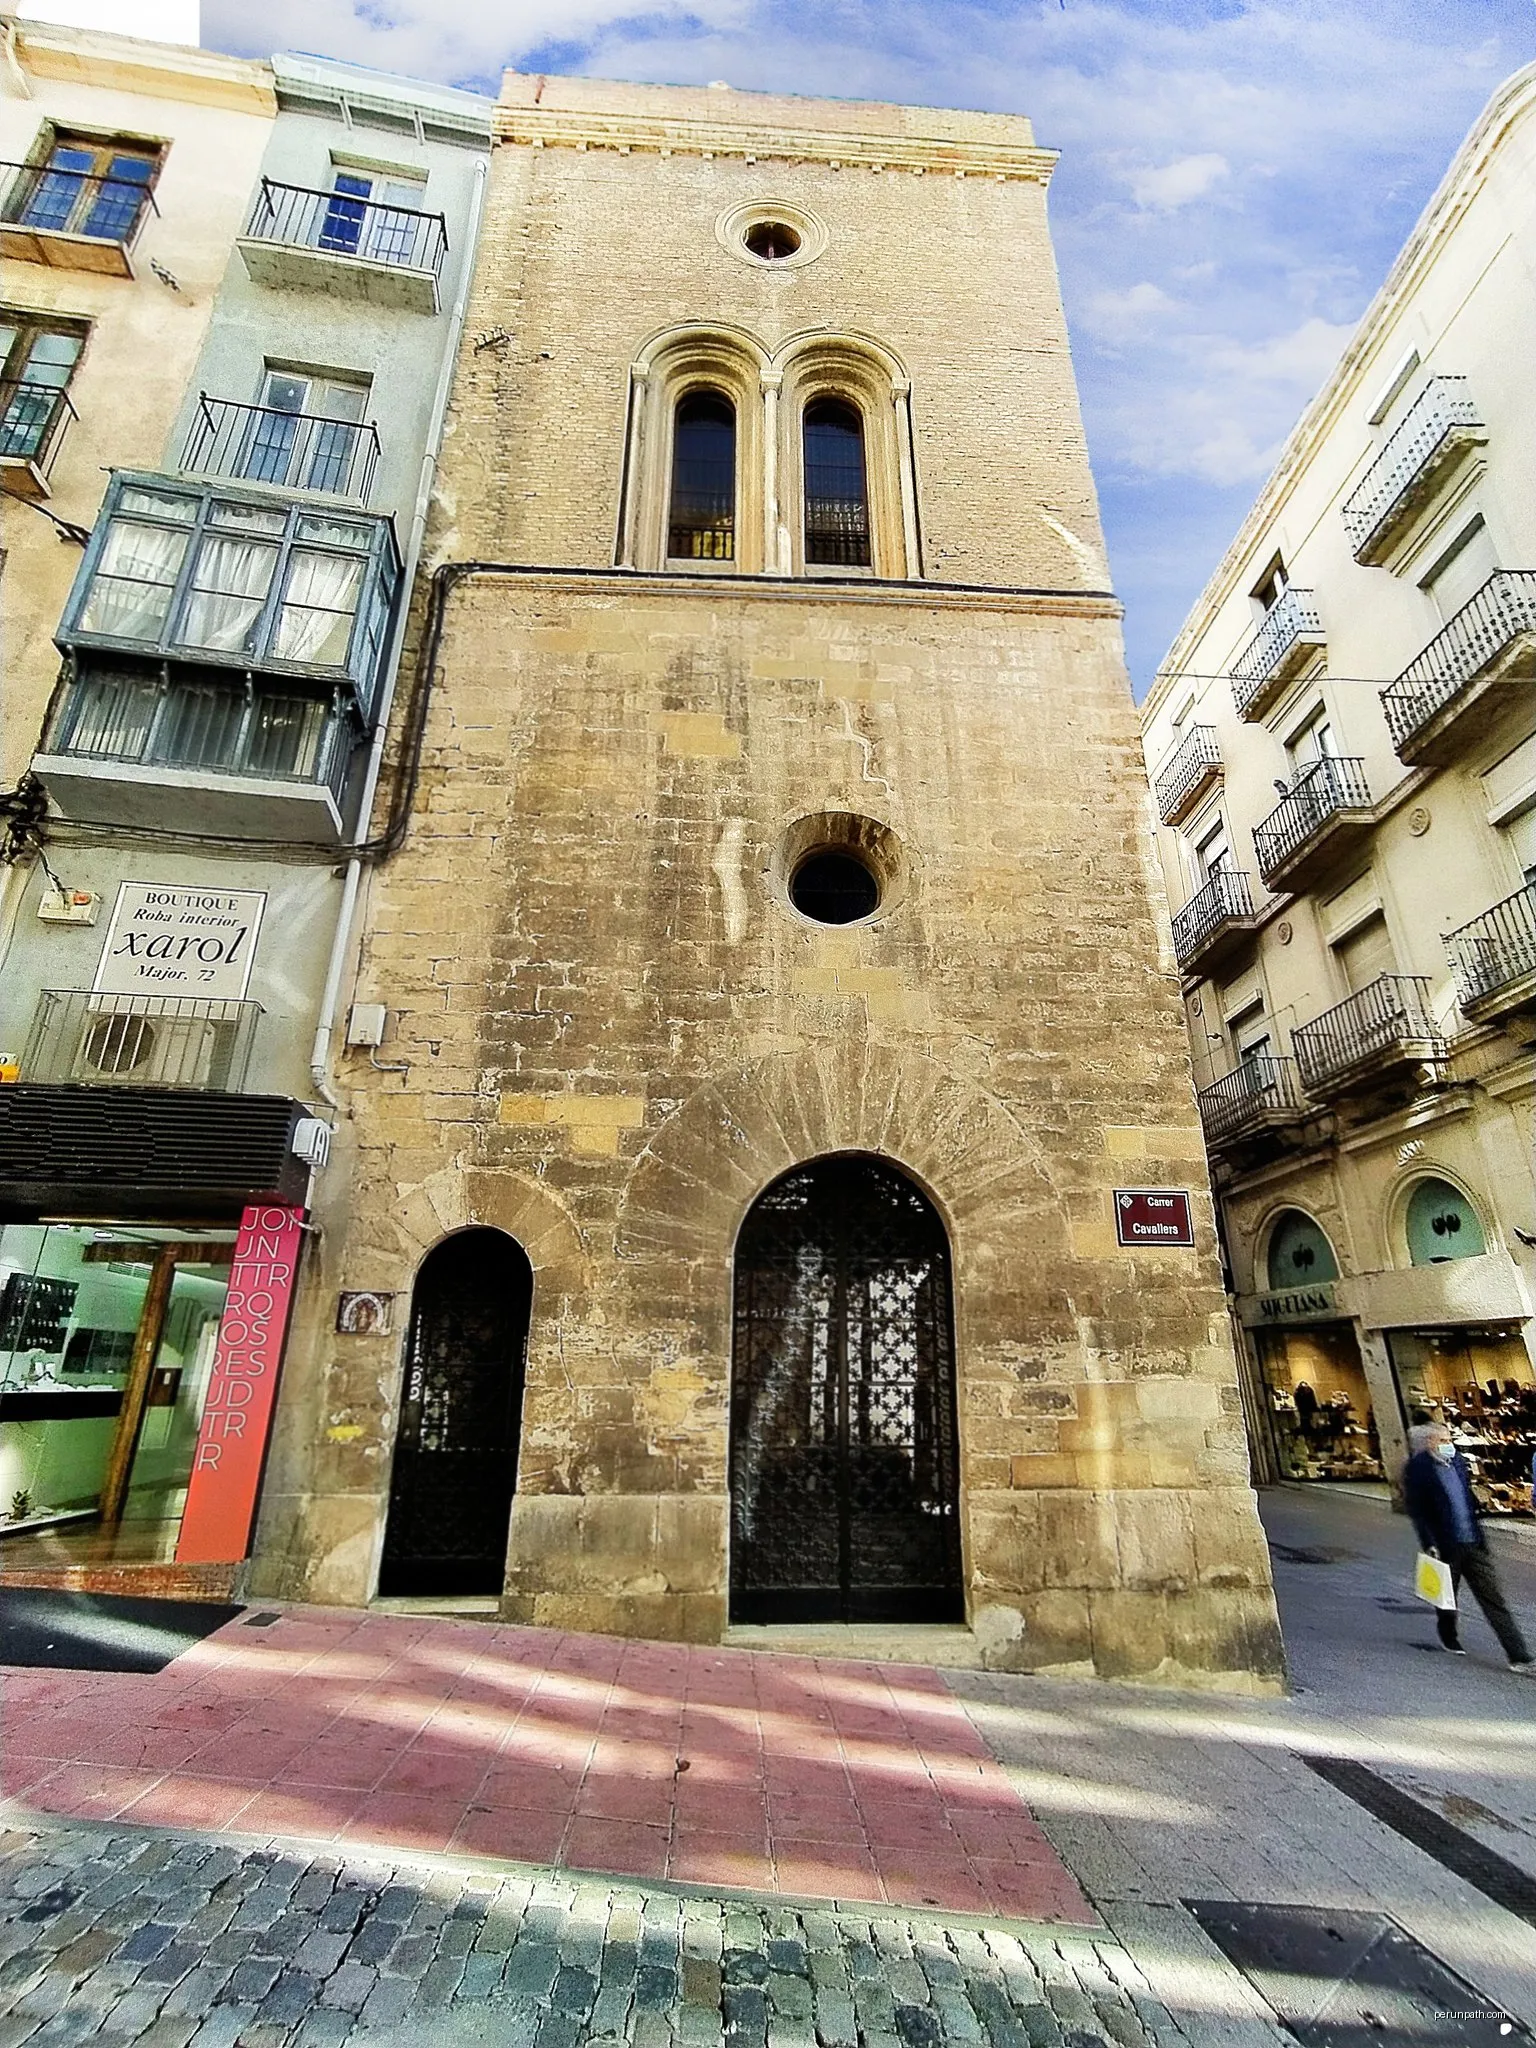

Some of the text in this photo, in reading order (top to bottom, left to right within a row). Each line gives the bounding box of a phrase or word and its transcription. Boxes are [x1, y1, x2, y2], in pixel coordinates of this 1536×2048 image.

[145, 892, 239, 911] BOUTIQUE
[133, 908, 240, 927] Roba interior
[113, 926, 248, 964] xarol
[197, 969, 216, 982] 72
[1147, 1196, 1174, 1207] Carrer
[1132, 1222, 1179, 1235] Cavallers
